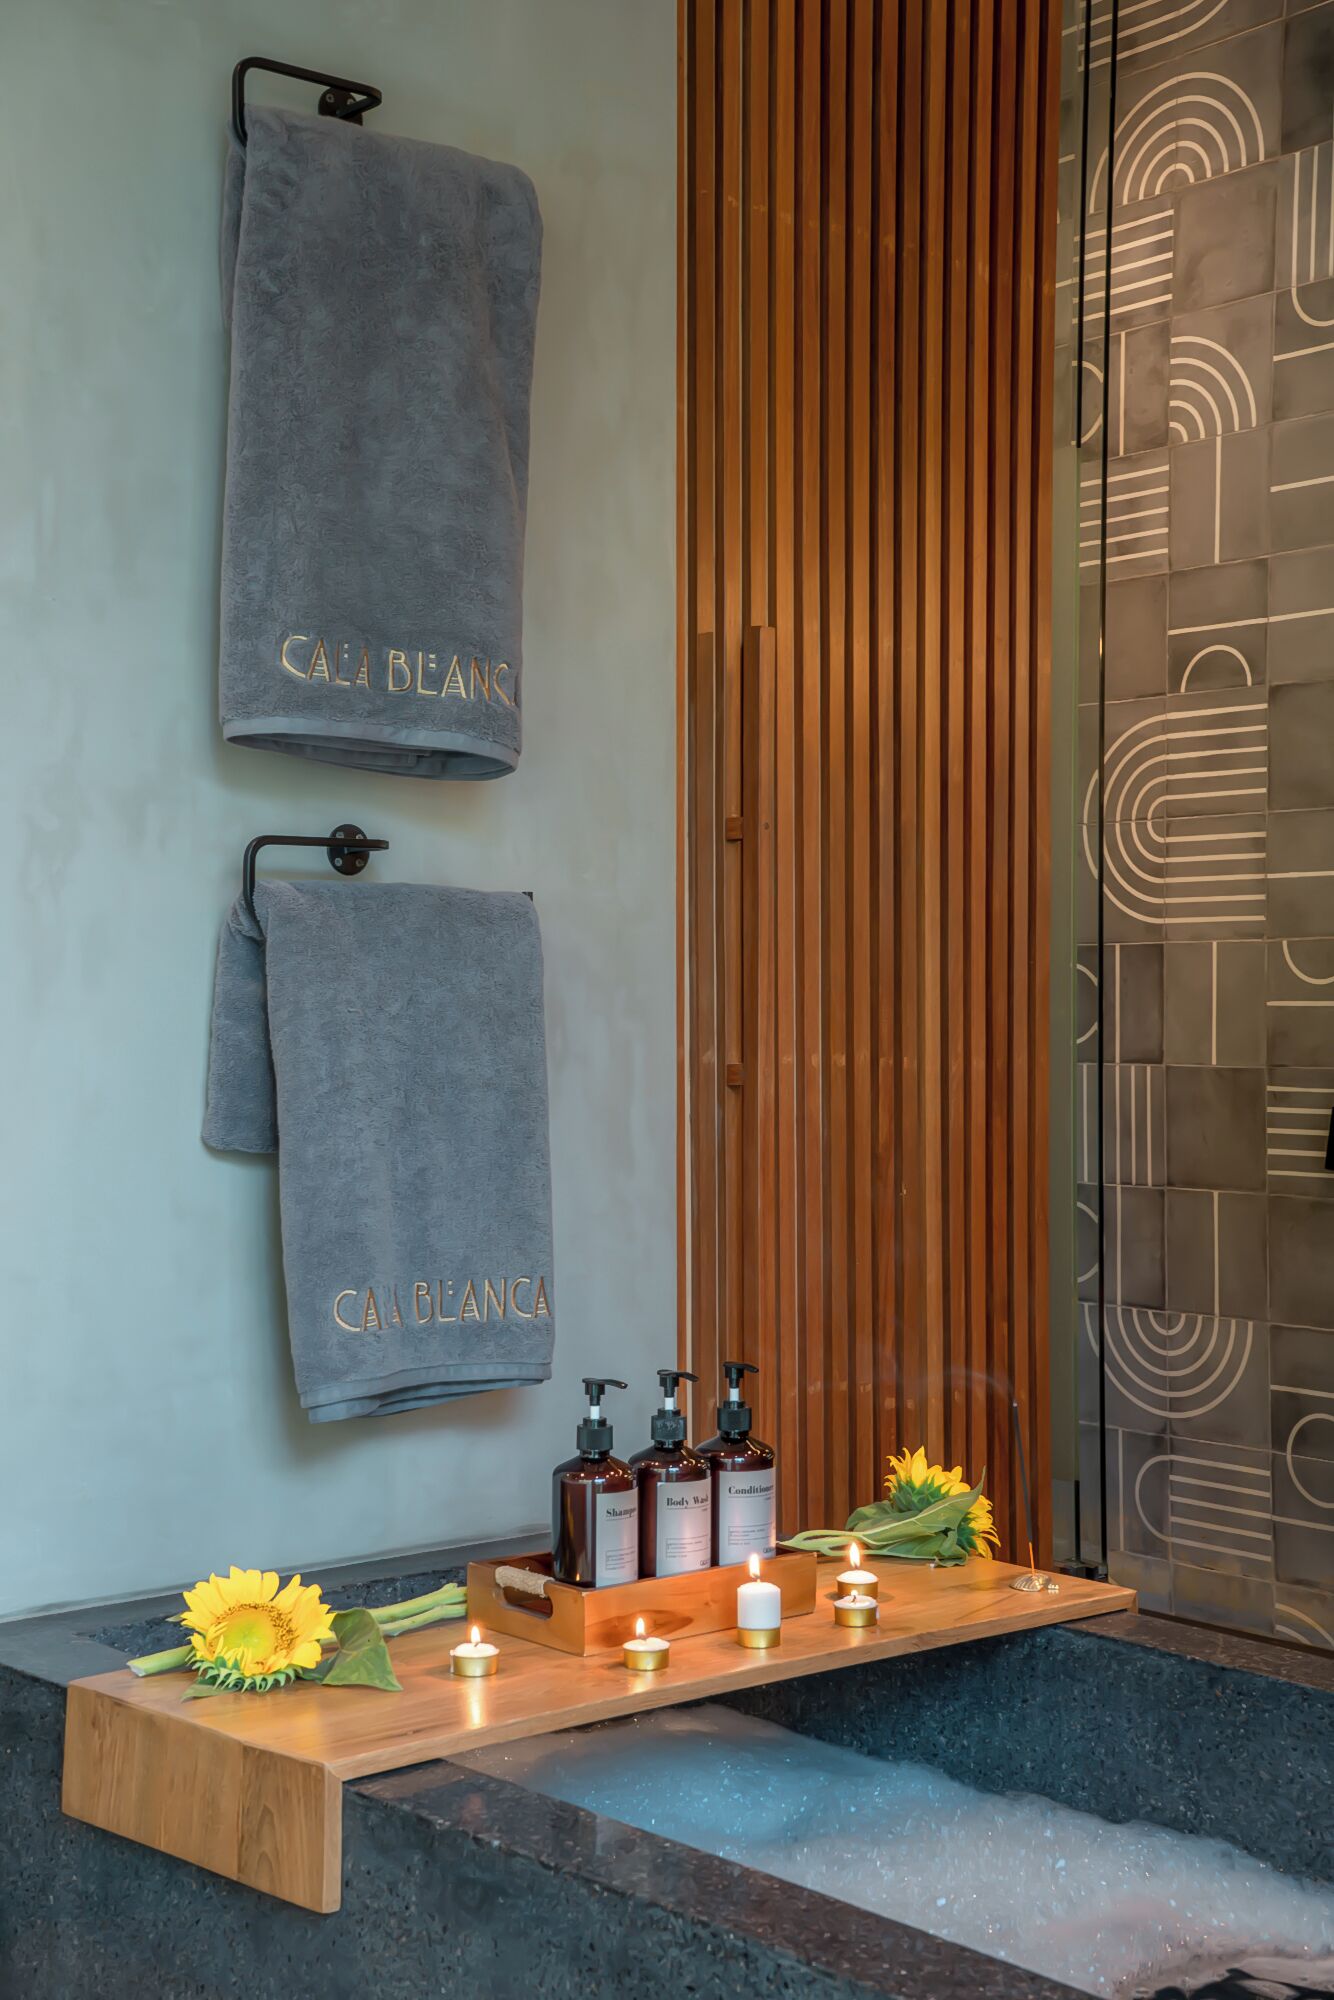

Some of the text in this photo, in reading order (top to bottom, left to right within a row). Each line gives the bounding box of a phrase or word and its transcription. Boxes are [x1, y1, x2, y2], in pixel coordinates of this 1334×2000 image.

[386, 649, 517, 706] BLANC
[414, 1276, 551, 1324] BLANCA
[666, 1497, 689, 1509] Body
